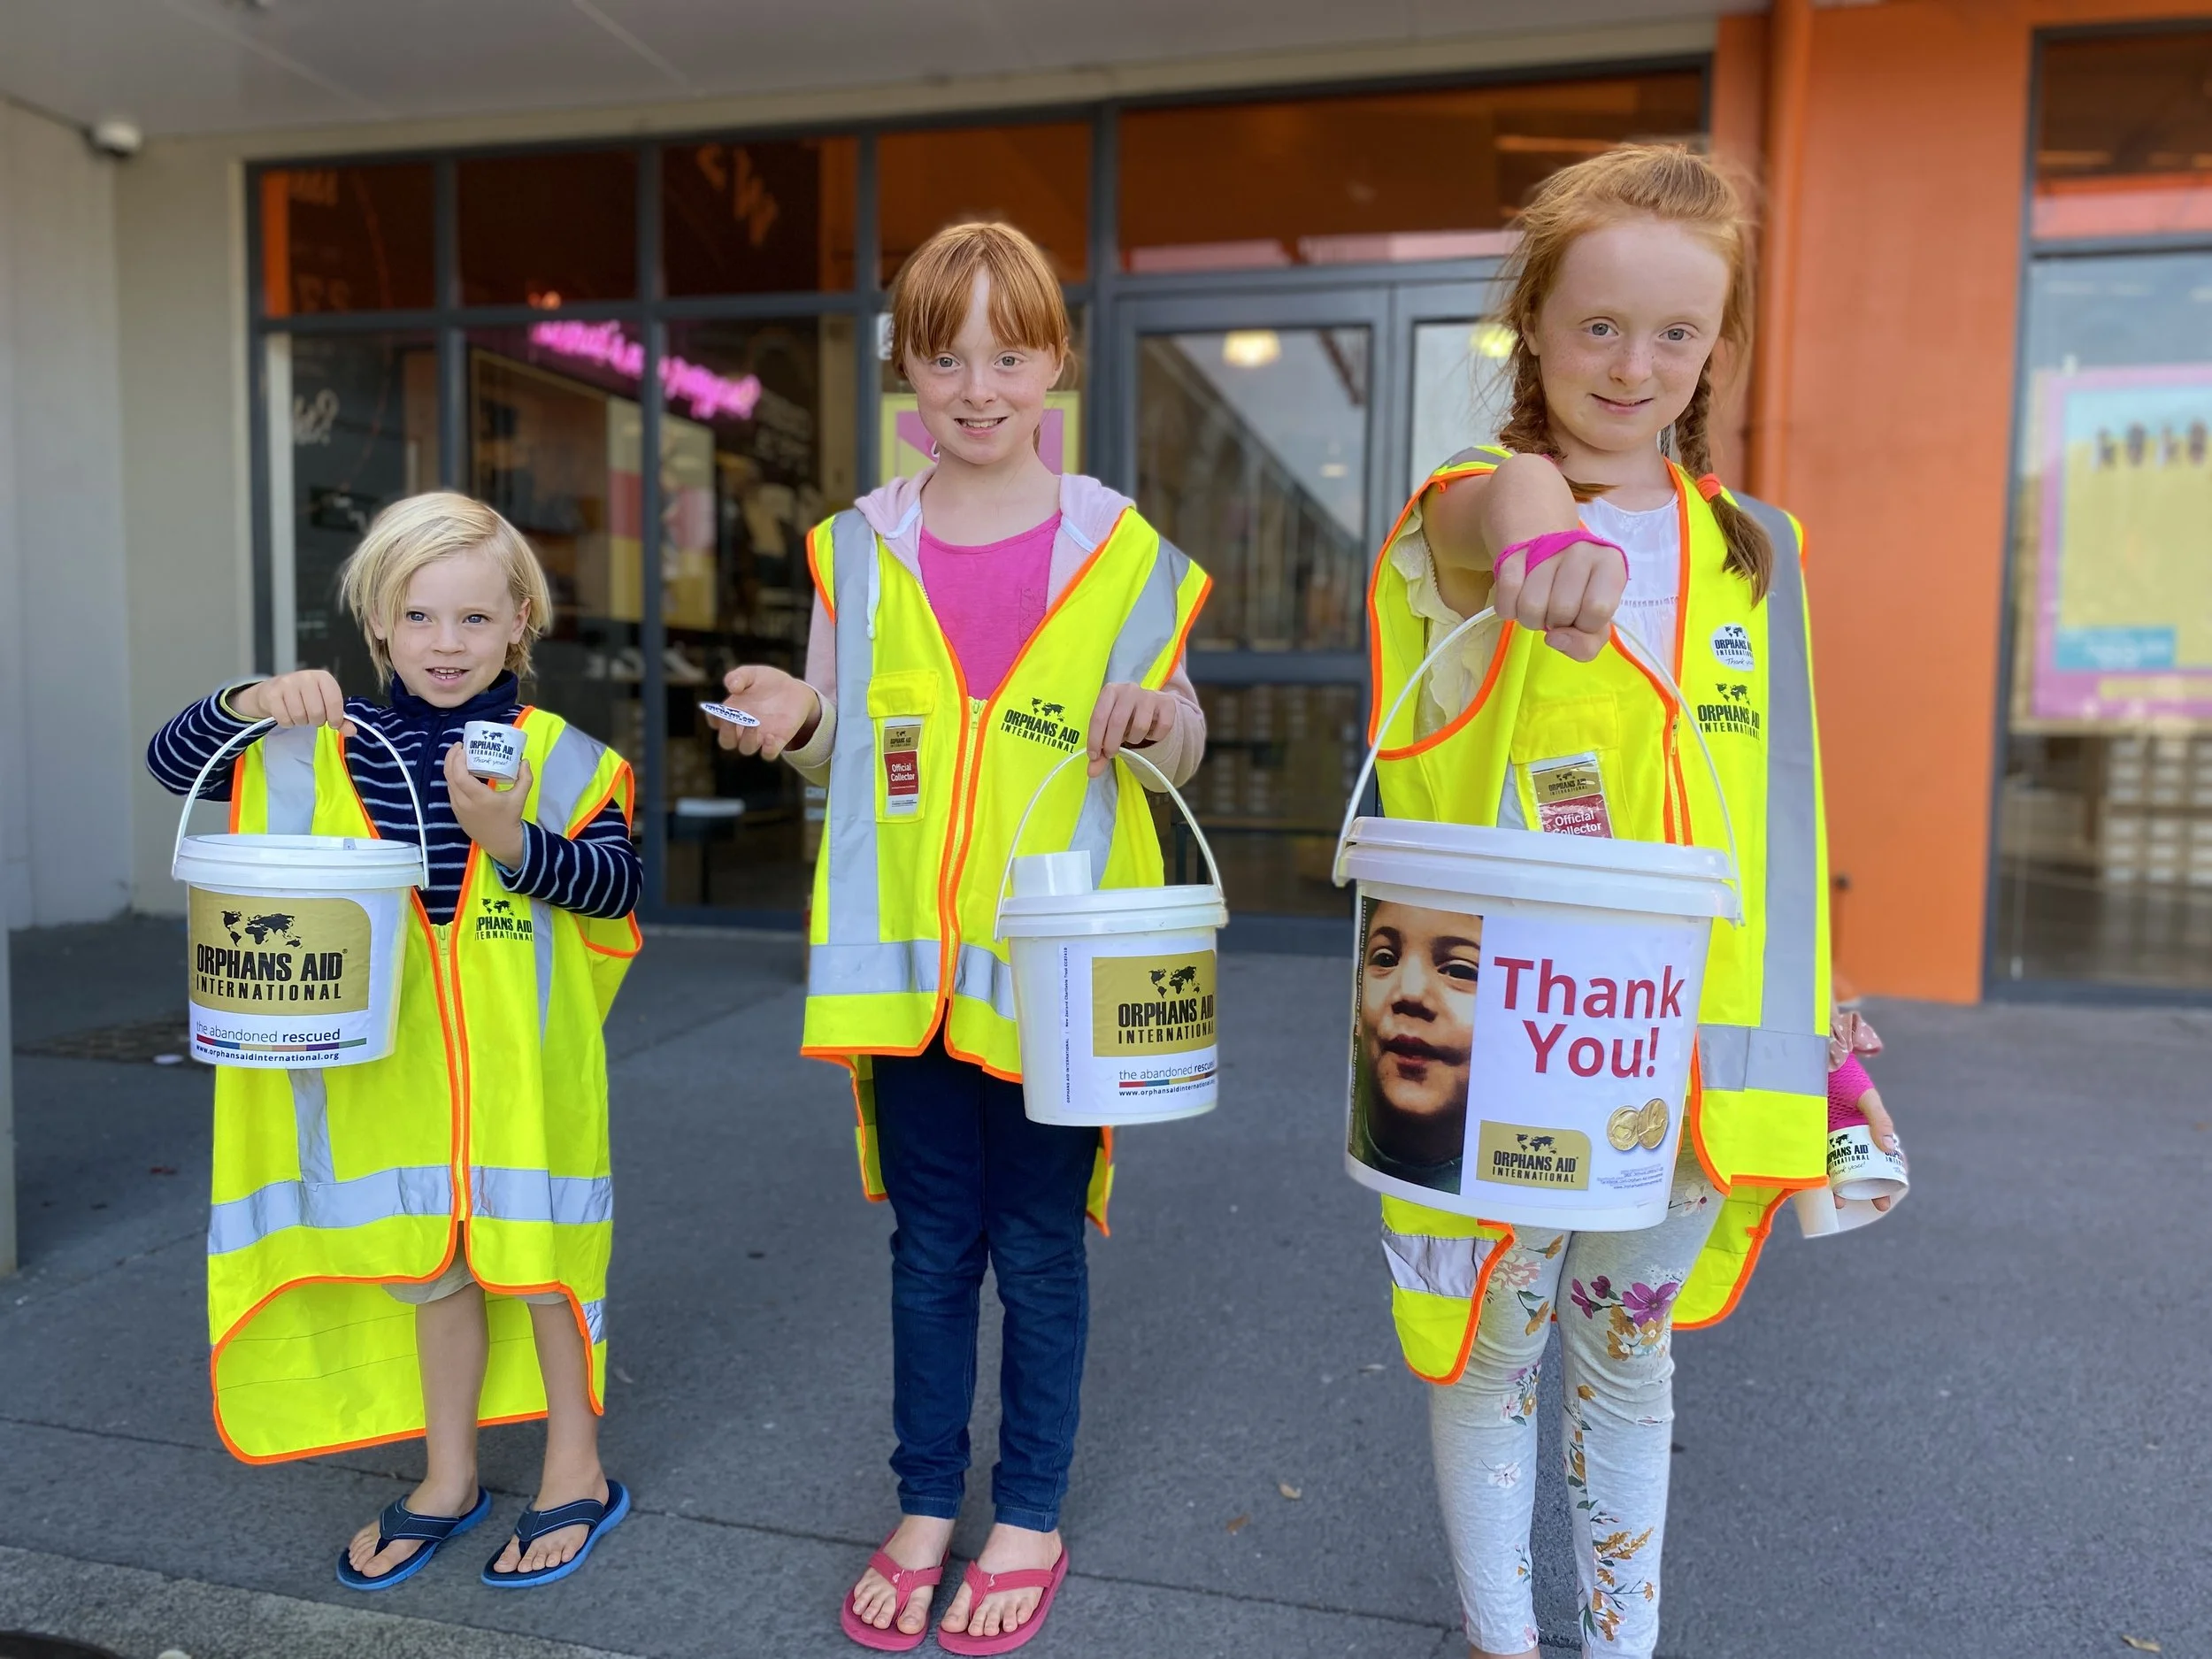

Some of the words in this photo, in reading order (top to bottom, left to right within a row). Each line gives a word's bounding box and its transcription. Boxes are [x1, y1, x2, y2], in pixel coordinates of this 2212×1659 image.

[1715, 639, 1747, 649] ORPHANS
[1697, 704, 1749, 725] ORPHANS
[1751, 710, 1760, 729] AID
[1003, 709, 1058, 737] ORPHANS
[1058, 726, 1080, 745] AID
[1699, 722, 1760, 741] INTERNATIONAL
[470, 740, 502, 752] ORPHANS
[503, 745, 514, 755] AID
[1001, 722, 1074, 754] INTERNATIONAL
[469, 749, 512, 761] INTERNATIONAL
[890, 772, 916, 781] Collector
[891, 763, 912, 772] Official
[1548, 780, 1576, 791] ORPHANS
[1555, 810, 1595, 826] Official
[476, 916, 513, 931] PHANS
[517, 919, 533, 933] AID
[475, 930, 534, 942] TERNATIONAL
[196, 943, 292, 981] ORPHANS
[300, 952, 343, 981] AID
[196, 973, 342, 1001] INTERNATIONAL
[1494, 956, 1686, 1019] Thank
[1118, 998, 1197, 1027] ORPHANS
[1201, 994, 1214, 1020] AID
[196, 1021, 207, 1034] the
[210, 1025, 278, 1042] abandoned
[282, 1028, 341, 1042] rescued
[1118, 1020, 1214, 1044] INTERNATIONAL
[196, 1045, 340, 1062] www.orphansaidinternational.org
[1522, 1019, 1660, 1079] You!
[1118, 1069, 1137, 1080] the
[1140, 1064, 1193, 1079] abandoned
[1194, 1059, 1216, 1072] rescue
[1118, 1079, 1216, 1096] www.orphansaidinternational.
[1494, 1150, 1553, 1171] ORPHANS
[1555, 1157, 1576, 1172] AID
[1827, 1146, 1852, 1164] PHANS
[1855, 1144, 1869, 1155] AID
[1493, 1166, 1575, 1183] INTERNATIONAL
